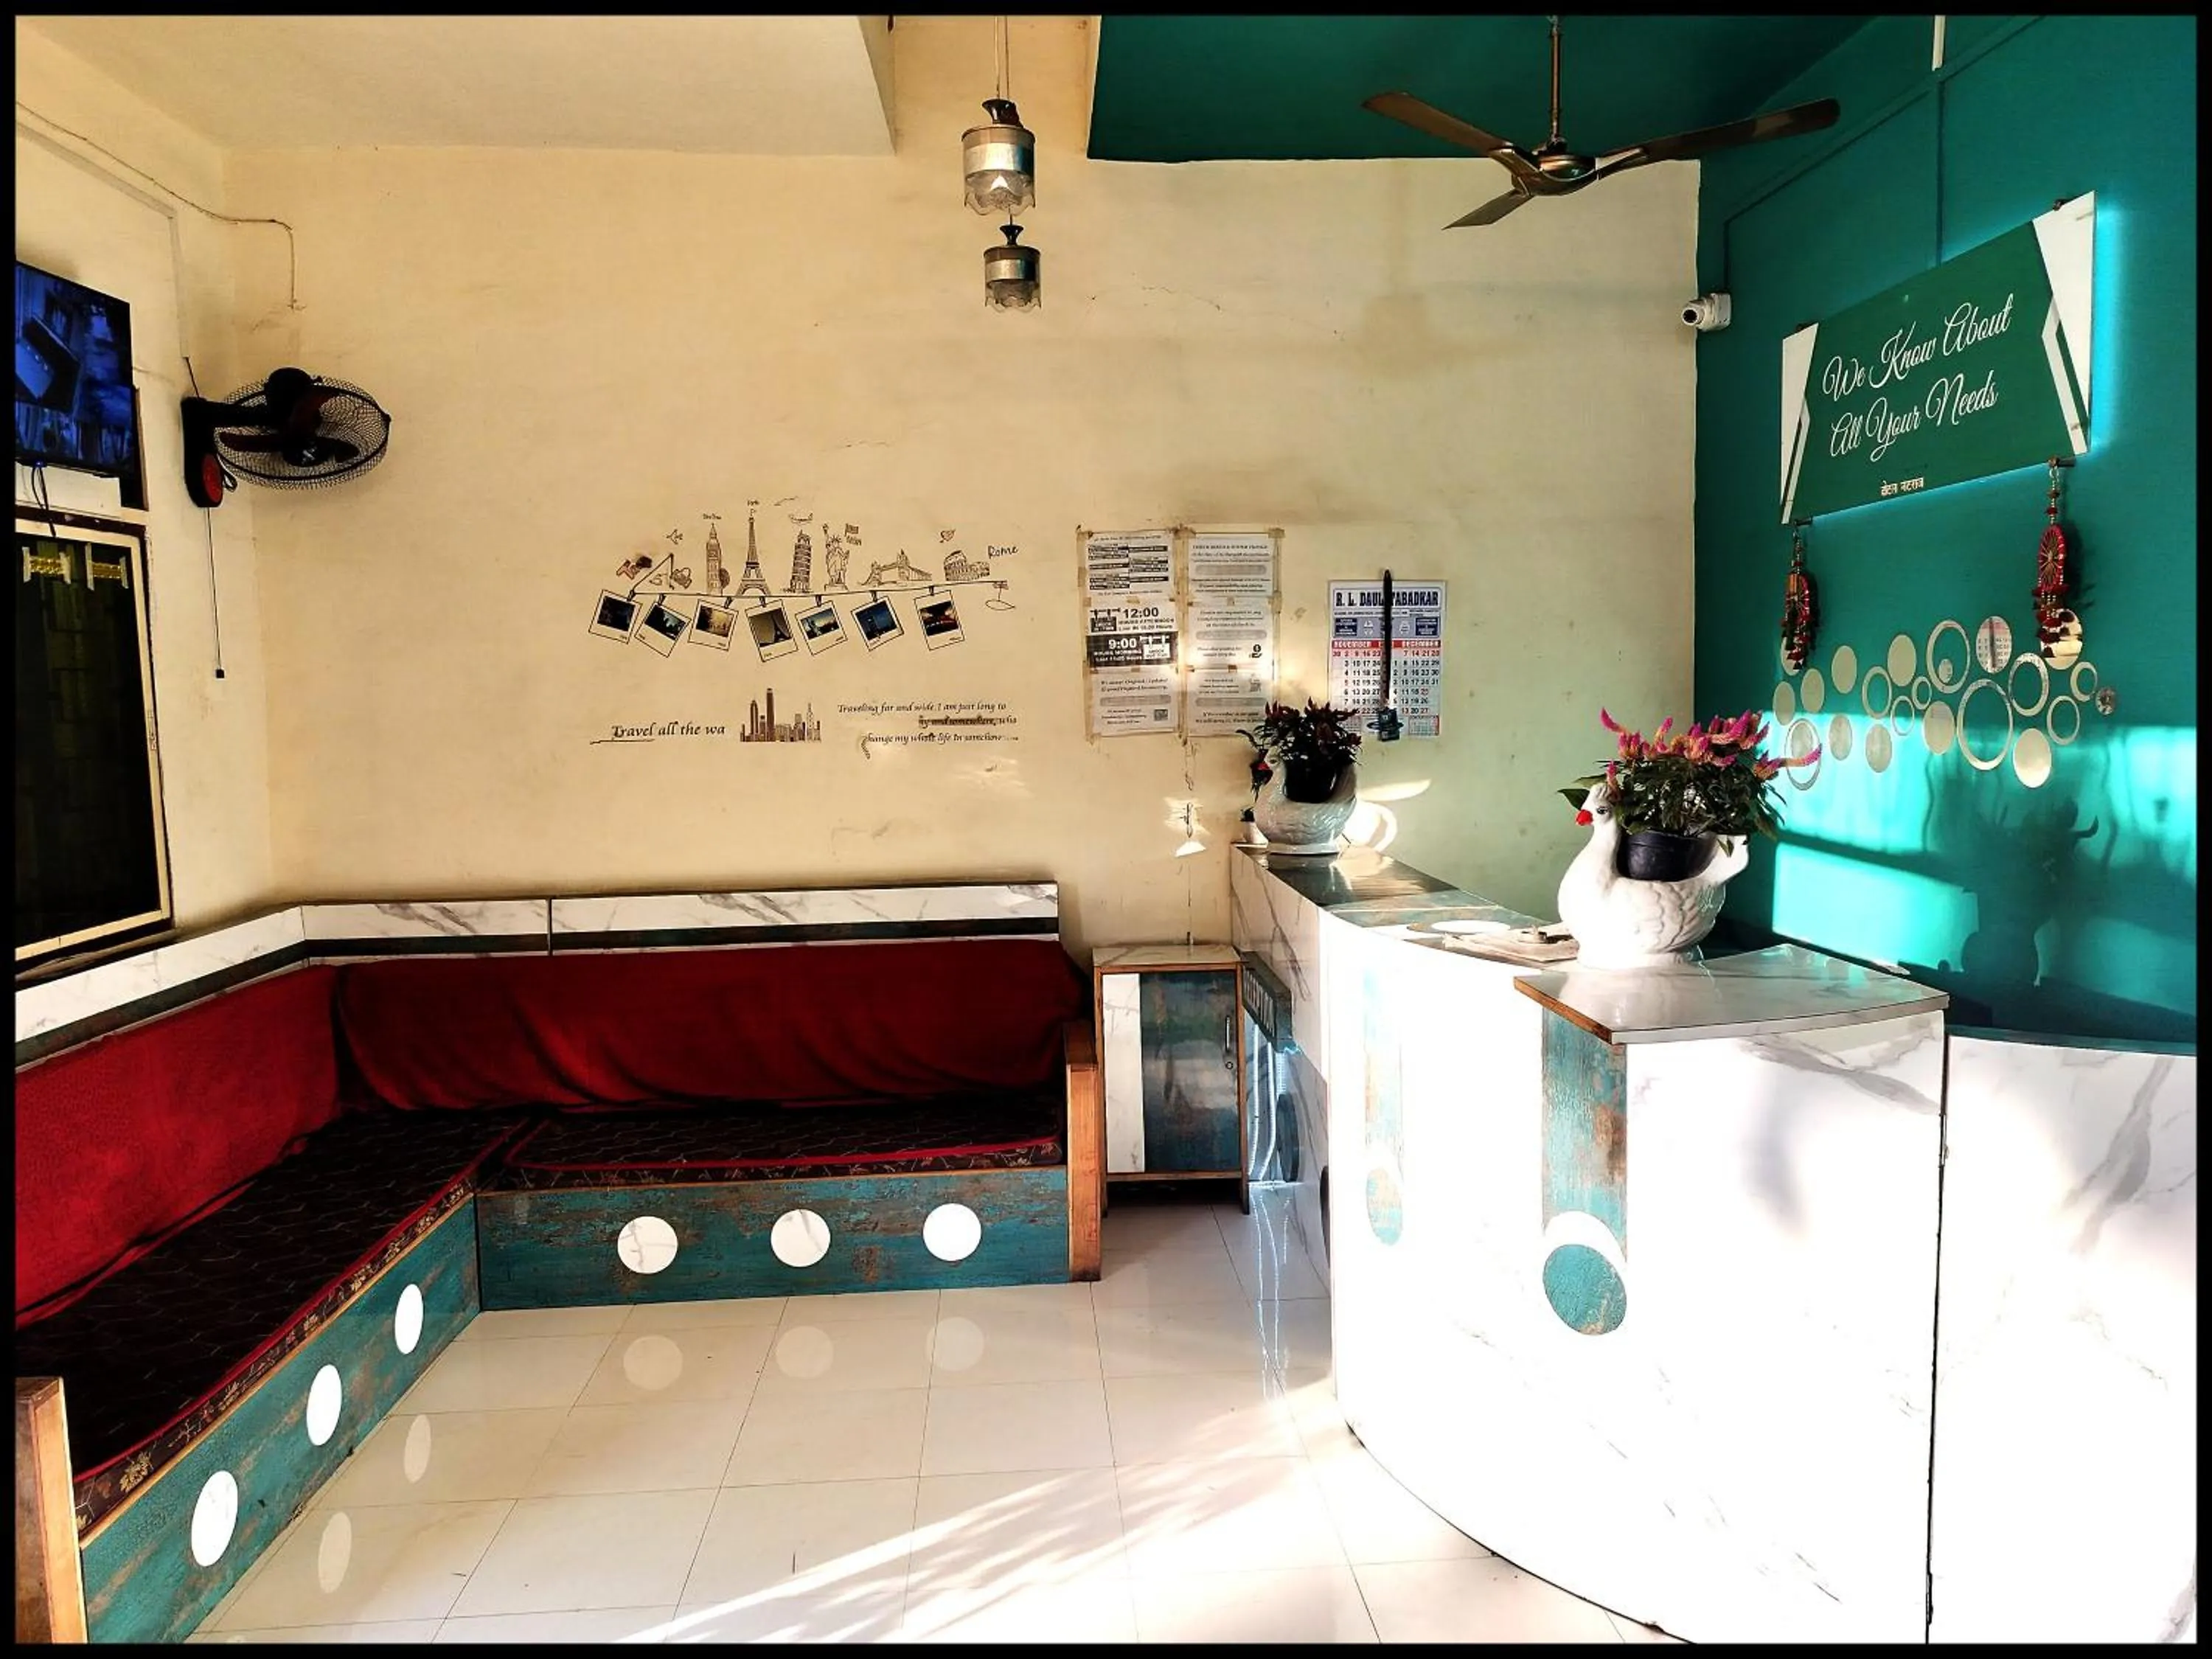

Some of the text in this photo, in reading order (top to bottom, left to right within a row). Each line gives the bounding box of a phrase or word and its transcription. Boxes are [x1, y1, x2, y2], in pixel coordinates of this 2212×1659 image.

[1823, 293, 2014, 401] We Know About
[1830, 369, 1999, 462] All Your Needs
[987, 545, 1019, 560] Rome
[1335, 591, 1346, 607] R.
[1360, 591, 1439, 607] DAULTABADKAR
[1122, 607, 1159, 619] 12:00
[1107, 638, 1137, 650] 9:00
[977, 702, 995, 714] long
[611, 720, 726, 738] Travel all the wa
